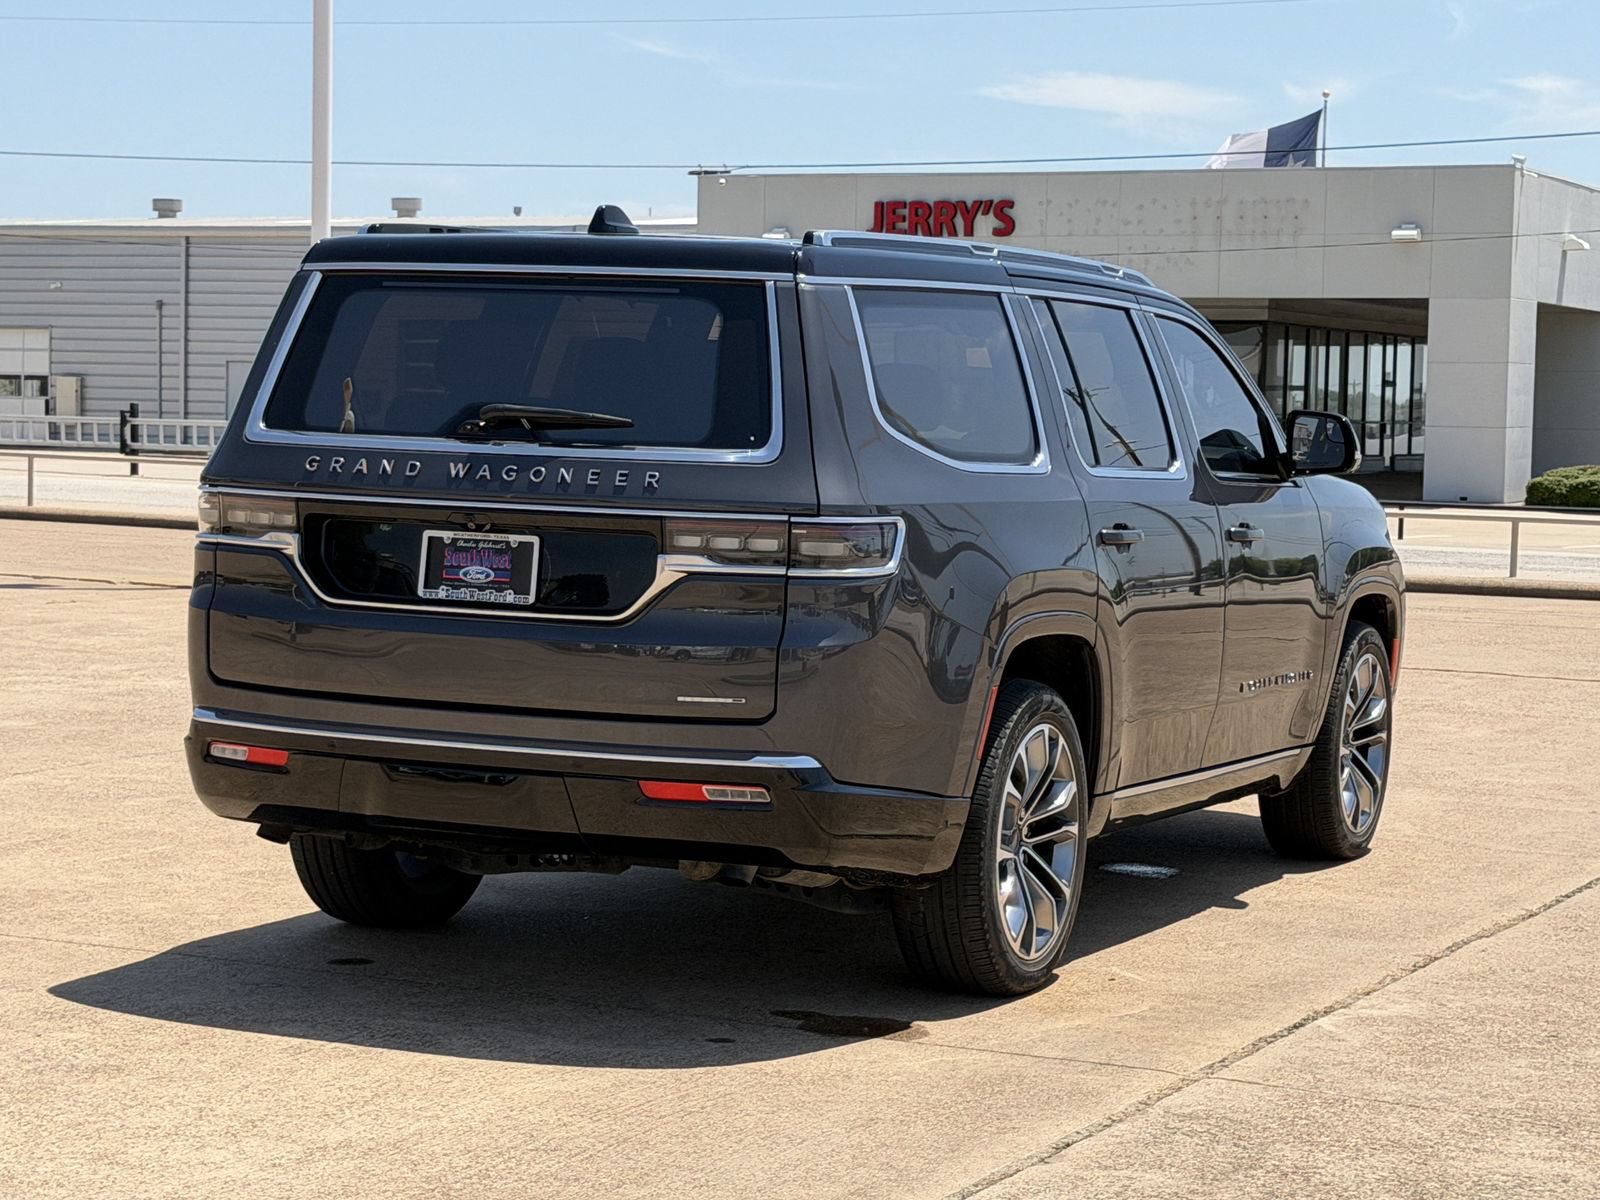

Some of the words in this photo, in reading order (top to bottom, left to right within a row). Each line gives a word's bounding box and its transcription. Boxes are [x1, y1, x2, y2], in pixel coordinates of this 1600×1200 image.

[866, 199, 1016, 237] JERRY'S
[305, 456, 421, 477] GRAND
[449, 462, 660, 488] WAGONEER
[466, 569, 487, 580] Ford
